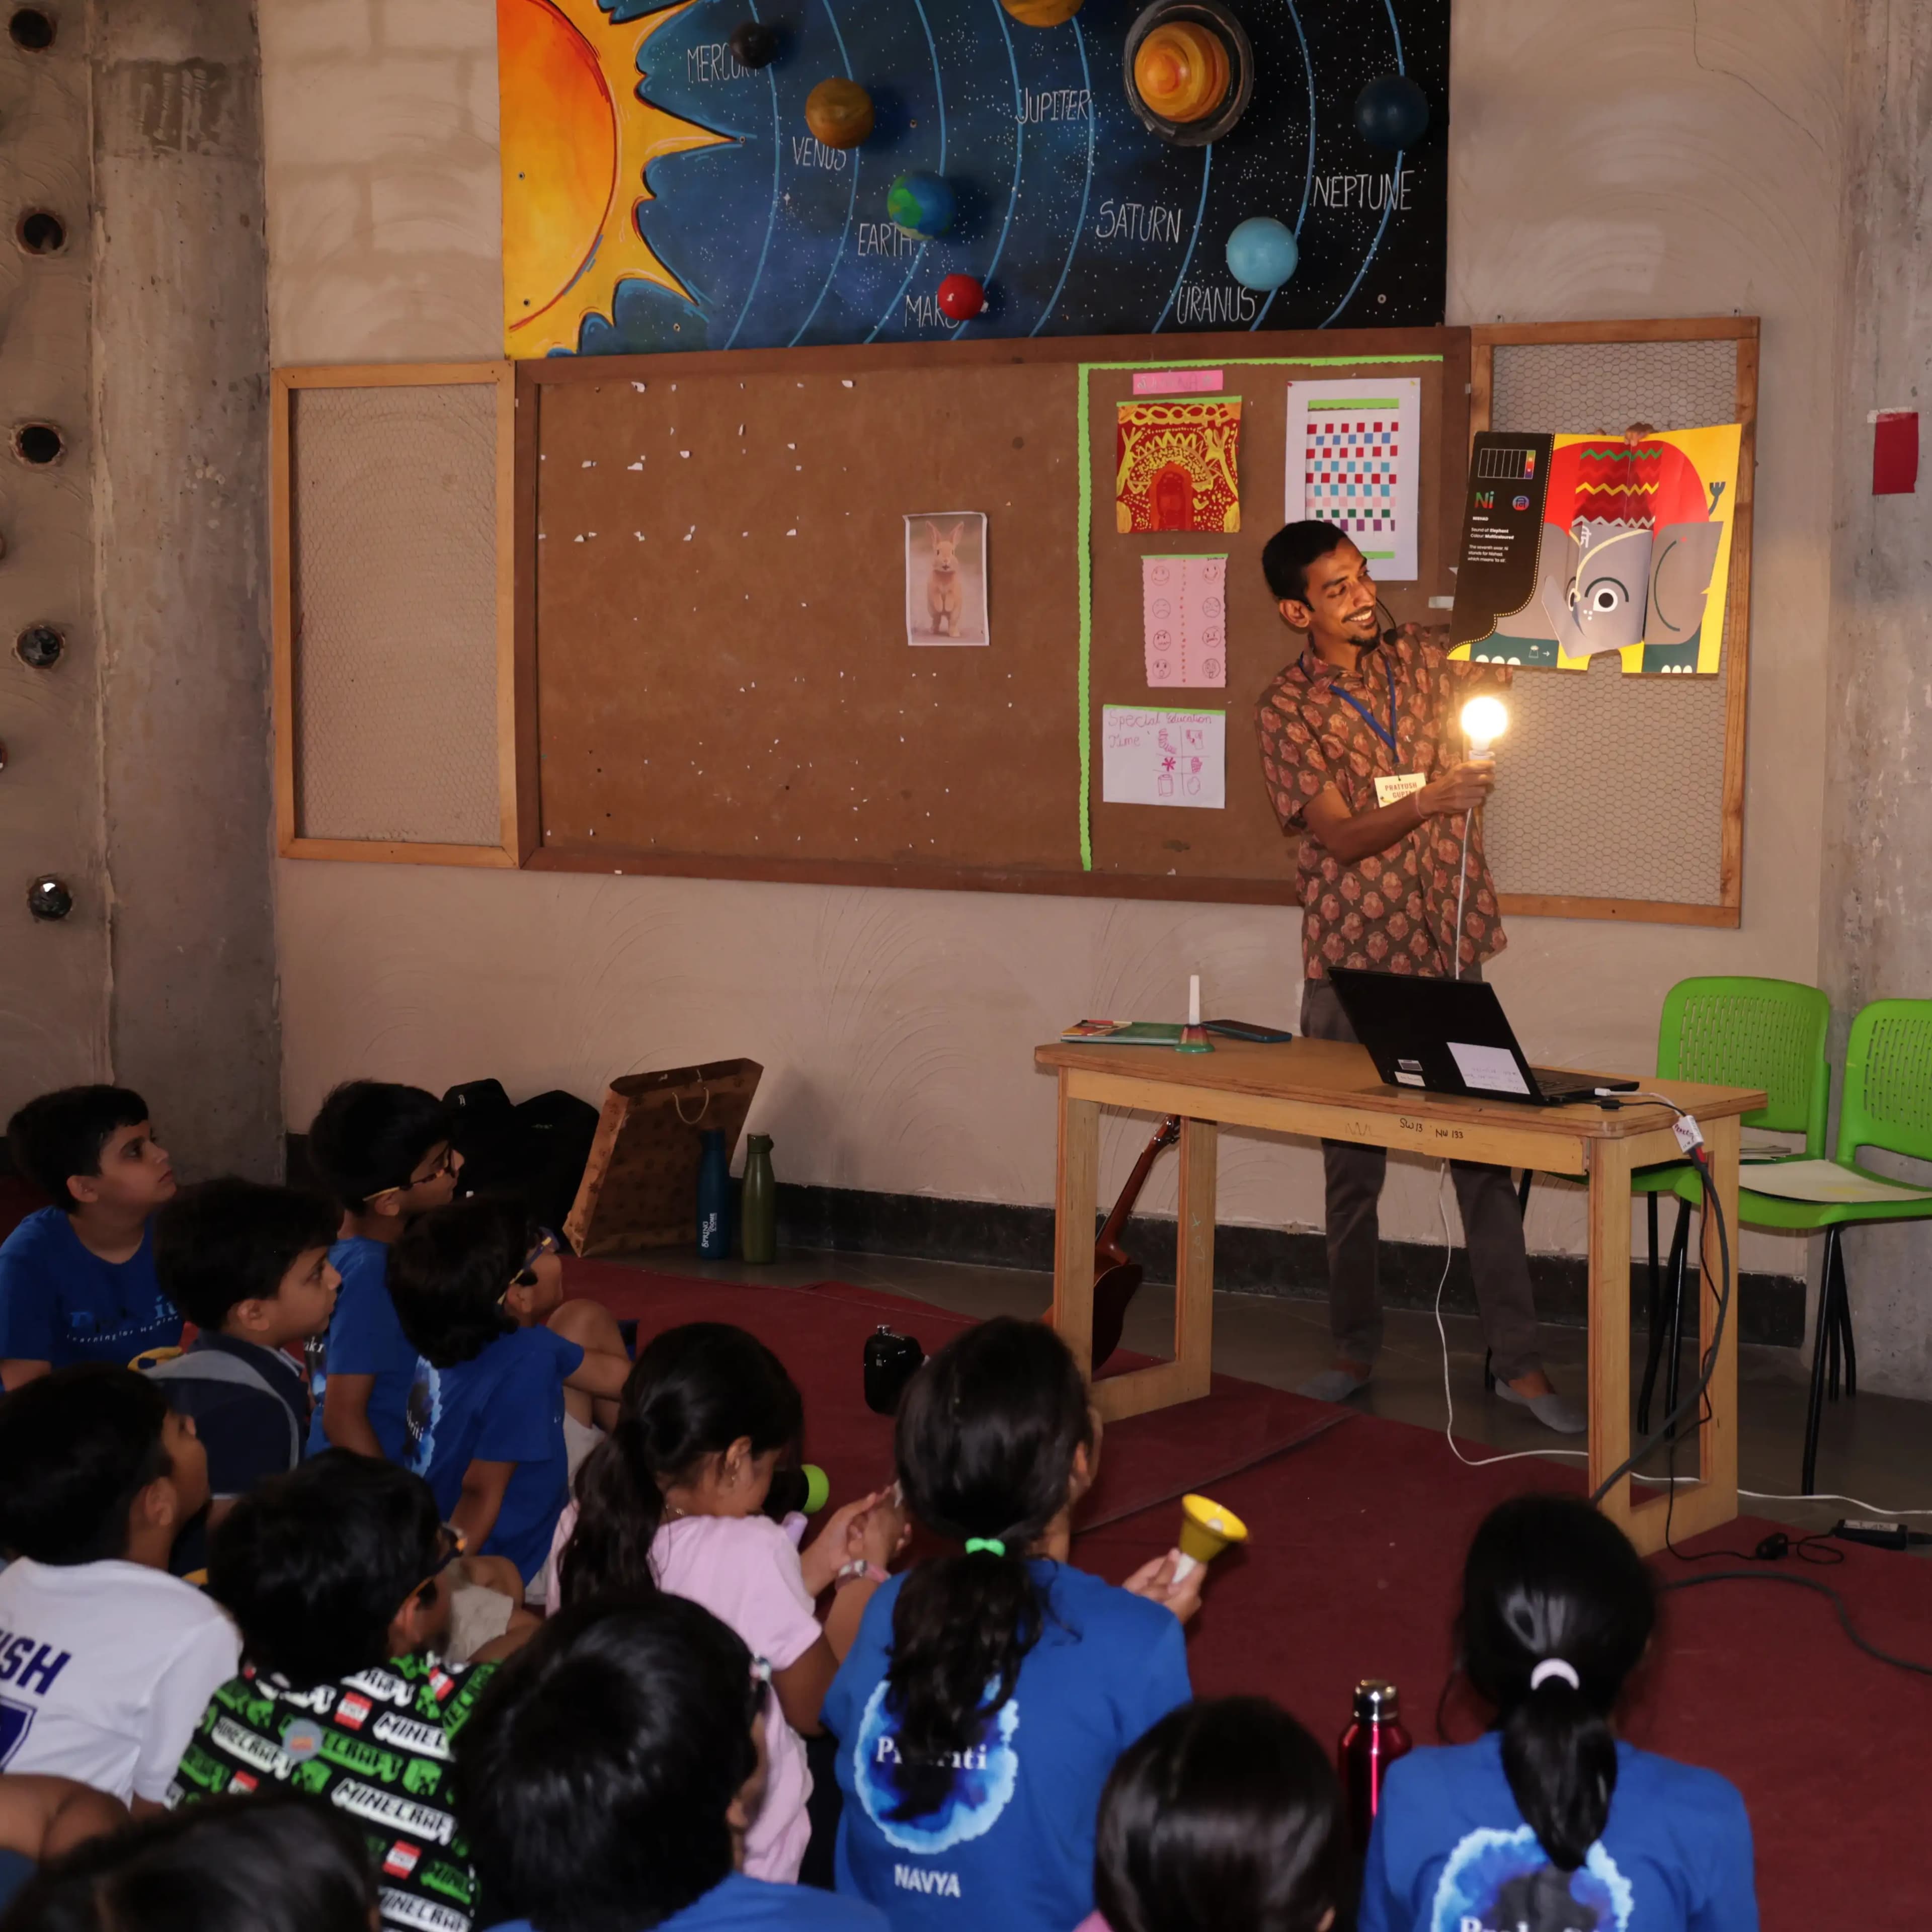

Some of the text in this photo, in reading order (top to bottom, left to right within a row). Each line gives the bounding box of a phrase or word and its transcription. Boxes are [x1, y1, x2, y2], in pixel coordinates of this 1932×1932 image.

[687, 42, 757, 83] MERCU
[1015, 88, 1090, 124] JUPITER
[792, 136, 846, 170] VENUS
[1313, 171, 1414, 210] NEPTUNE
[1096, 201, 1181, 244] SATURN
[858, 223, 912, 257] EARTH
[1177, 285, 1256, 324] URANUS
[1474, 491, 1494, 509] Ni
[1108, 710, 1212, 729] Special Education
[1108, 734, 1141, 748] Time
[1385, 782, 1417, 791] PRATYUSH
[1416, 1123, 1423, 1132] 13
[1452, 1131, 1464, 1139] 133
[895, 1864, 961, 1898] NAVYA
